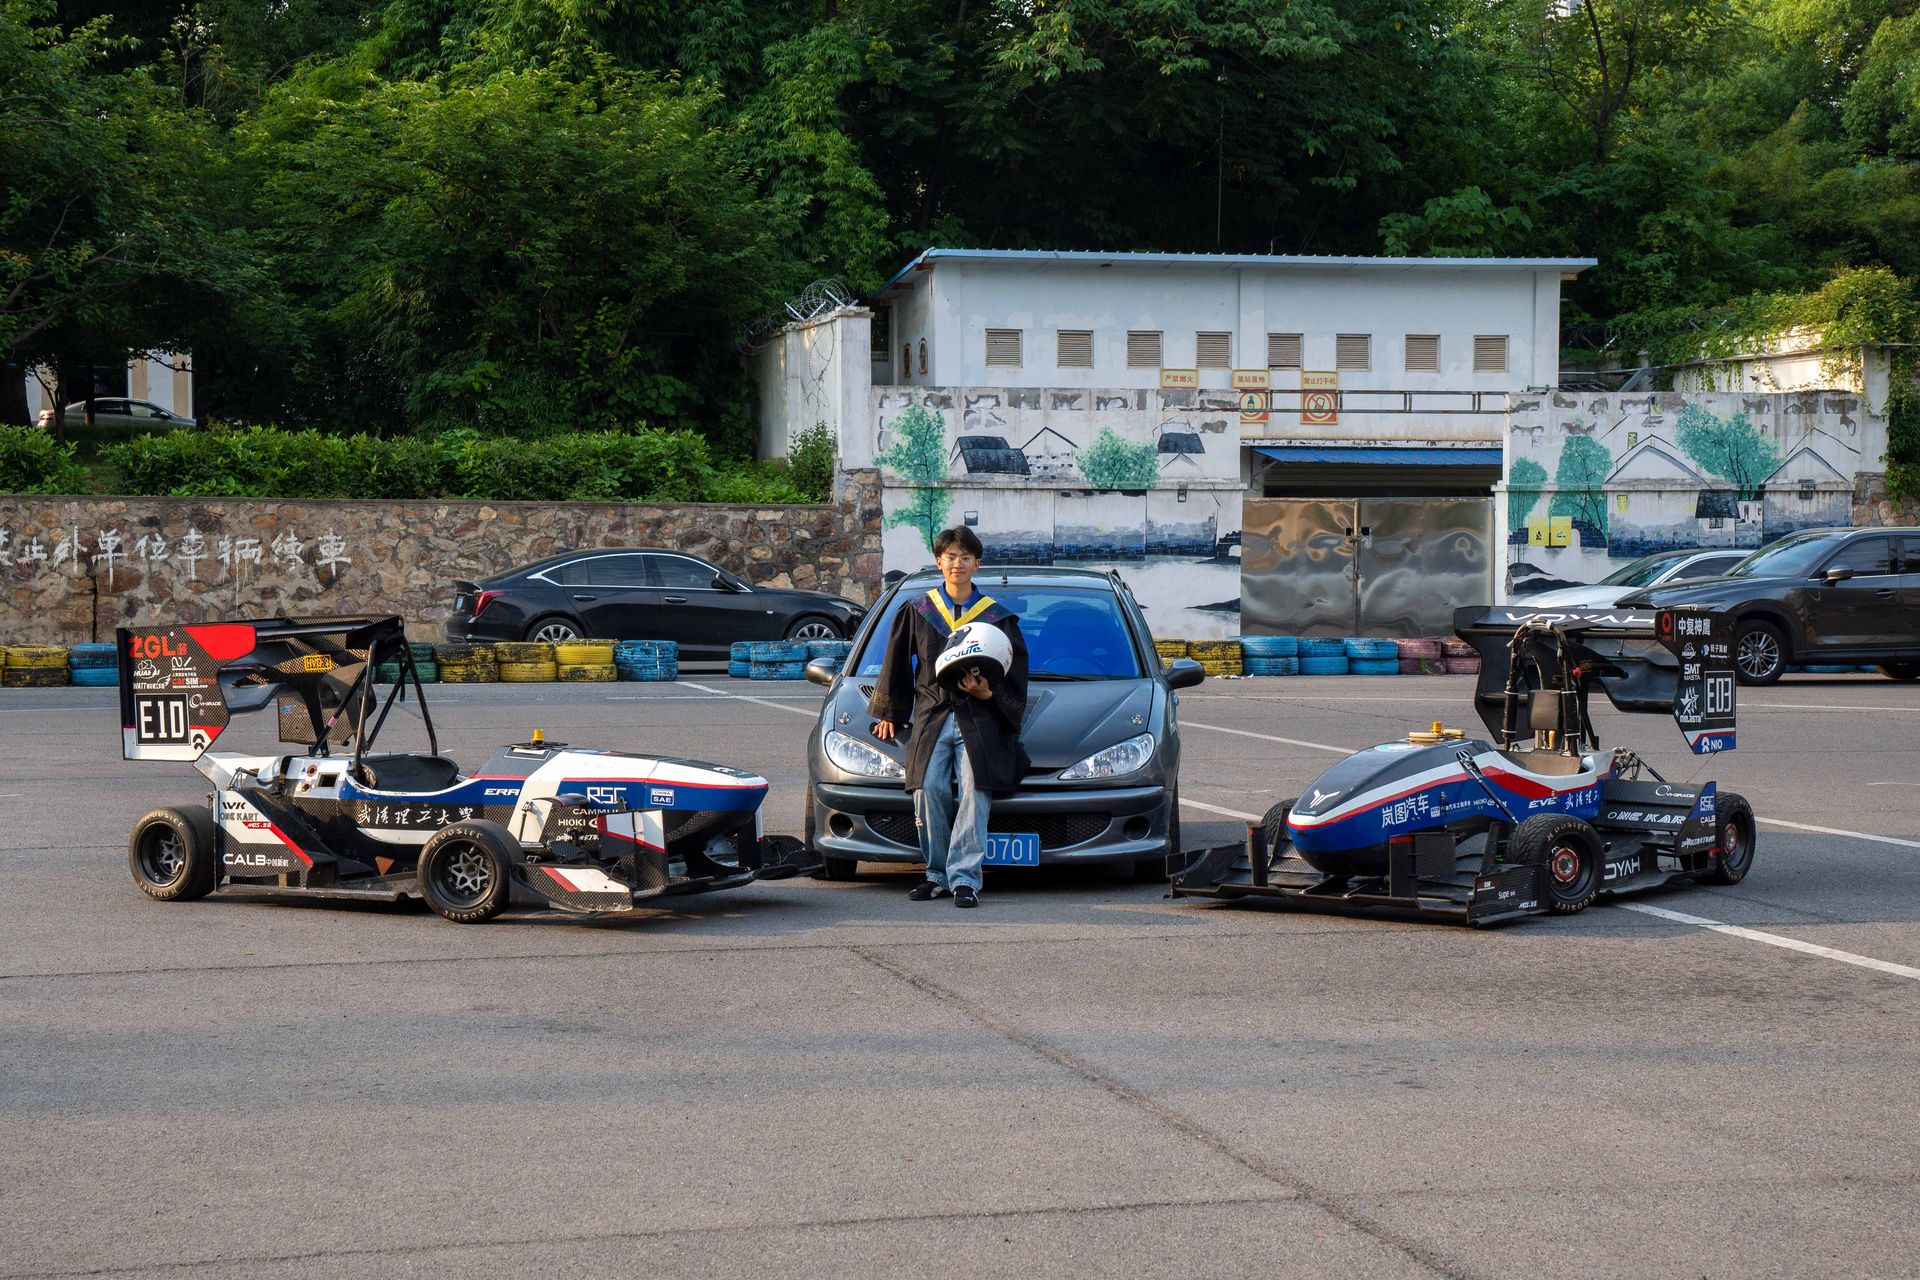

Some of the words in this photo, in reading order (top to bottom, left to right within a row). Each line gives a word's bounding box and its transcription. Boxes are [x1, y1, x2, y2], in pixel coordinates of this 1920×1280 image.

[129, 634, 177, 659] ZGL
[1684, 663, 1701, 675] SMT
[1707, 678, 1732, 713] E03
[140, 701, 184, 738] E10
[1711, 738, 1723, 750] NIO
[484, 788, 520, 796] ERA
[1528, 796, 1558, 809] EVE
[220, 812, 236, 821] ONE
[237, 812, 259, 821] KART
[1382, 793, 1429, 828] 岚图汽车
[558, 818, 586, 826] HIOKI
[1643, 813, 1686, 825] KAR
[985, 838, 1032, 861] 0701
[223, 853, 266, 866] CALB
